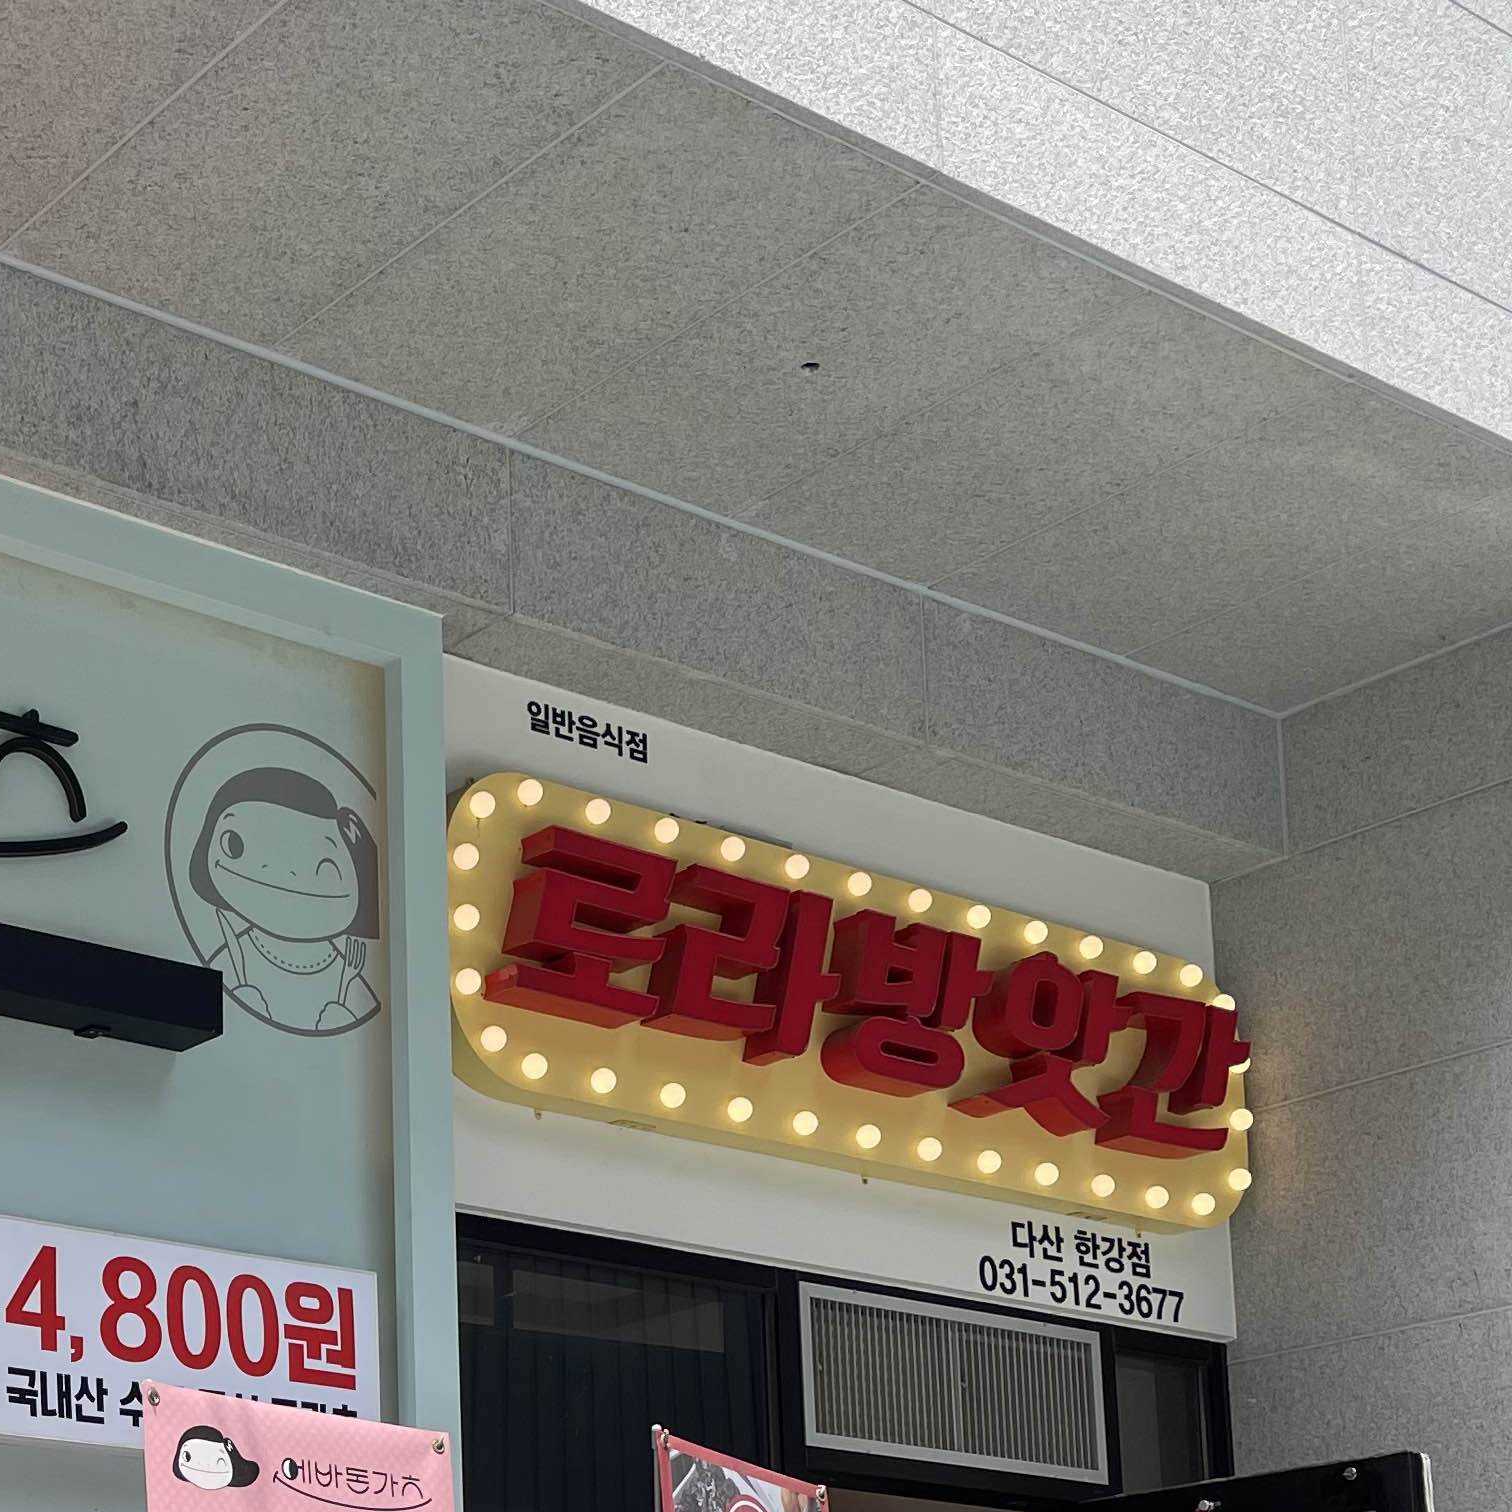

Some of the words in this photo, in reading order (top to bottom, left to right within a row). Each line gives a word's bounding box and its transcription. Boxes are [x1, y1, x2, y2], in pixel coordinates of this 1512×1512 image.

[526, 700, 649, 763] 일반음식점
[483, 826, 1251, 1160] 로라방앗간
[1010, 1220, 1064, 1259] 다산
[1074, 1230, 1152, 1280] 한강점
[5, 1244, 357, 1391] 4,800원
[978, 1256, 1185, 1324] 031-512-3677
[5, 1366, 109, 1426] 국내산
